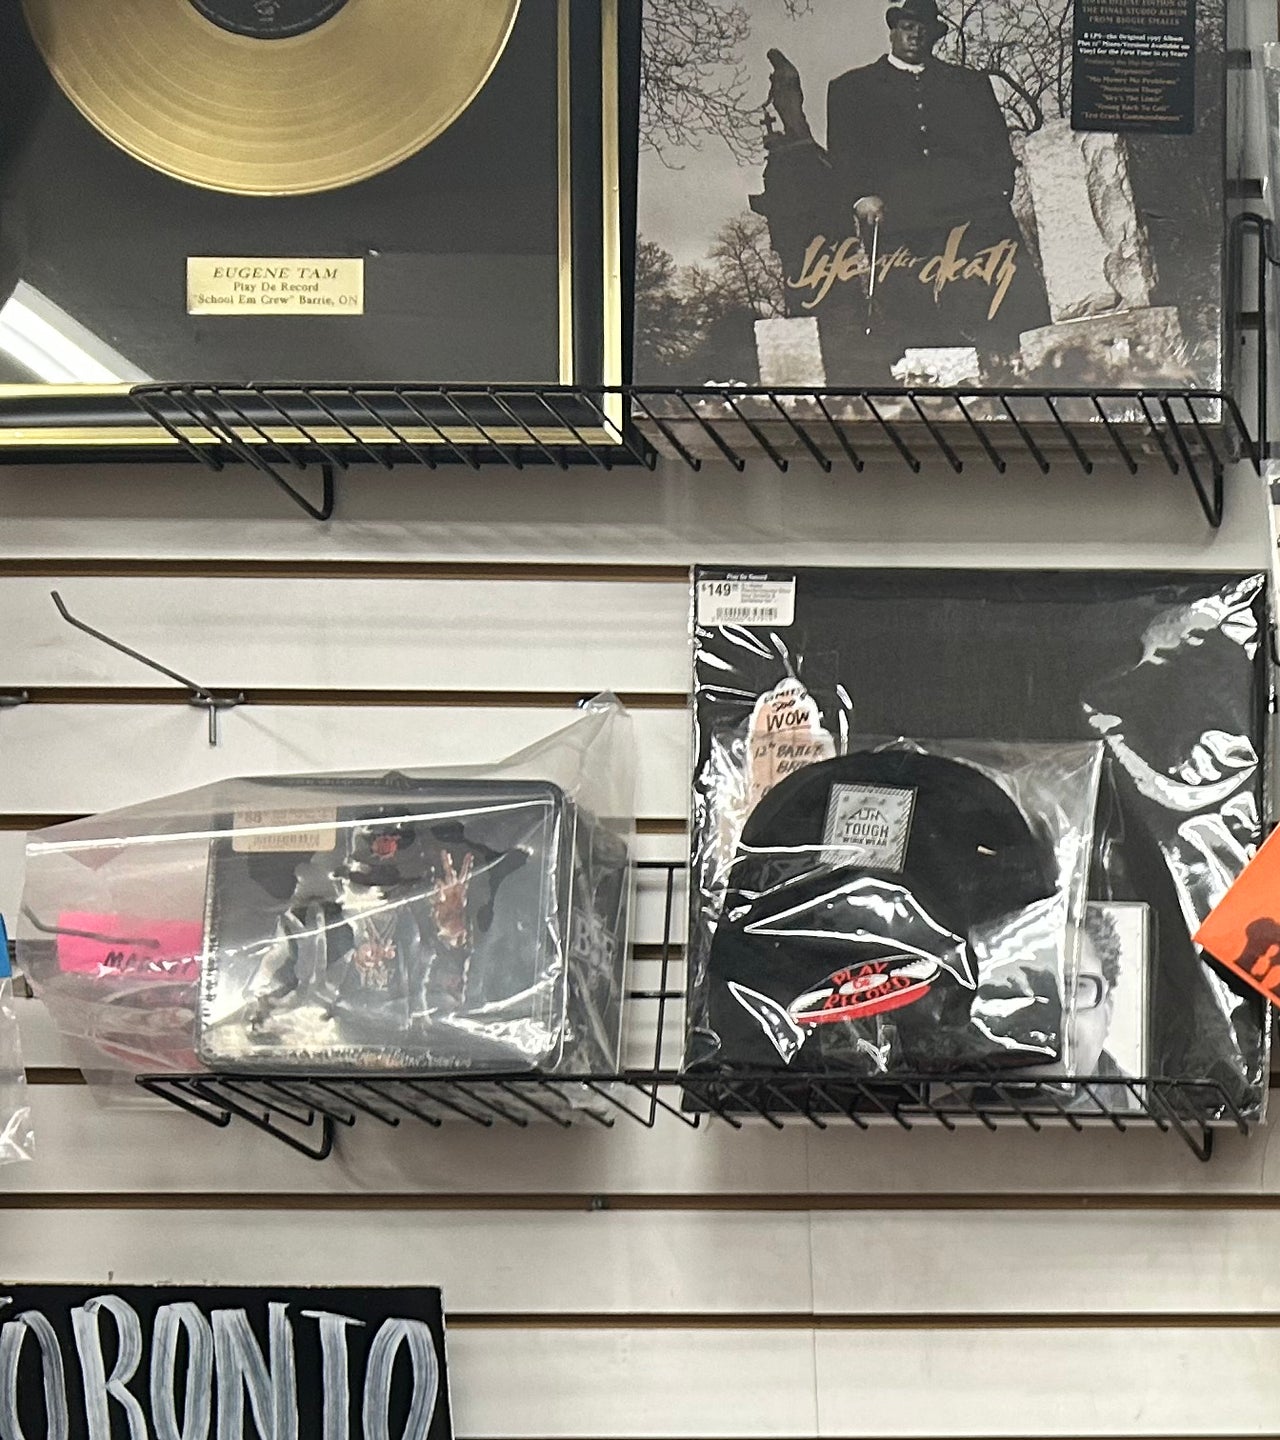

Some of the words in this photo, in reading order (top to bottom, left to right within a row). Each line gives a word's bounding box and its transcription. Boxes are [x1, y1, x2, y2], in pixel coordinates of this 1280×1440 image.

[213, 267, 290, 279] EUGENE
[297, 267, 338, 279] TAM
[787, 233, 872, 310] Life
[918, 220, 1019, 321] death
[233, 281, 256, 293] Play
[261, 282, 276, 293] De
[281, 281, 319, 292] Record
[238, 295, 256, 305] Em
[339, 295, 359, 305] ON
[701, 583, 731, 597] $149
[767, 711, 811, 732] WOW
[845, 823, 889, 838] TOUGH
